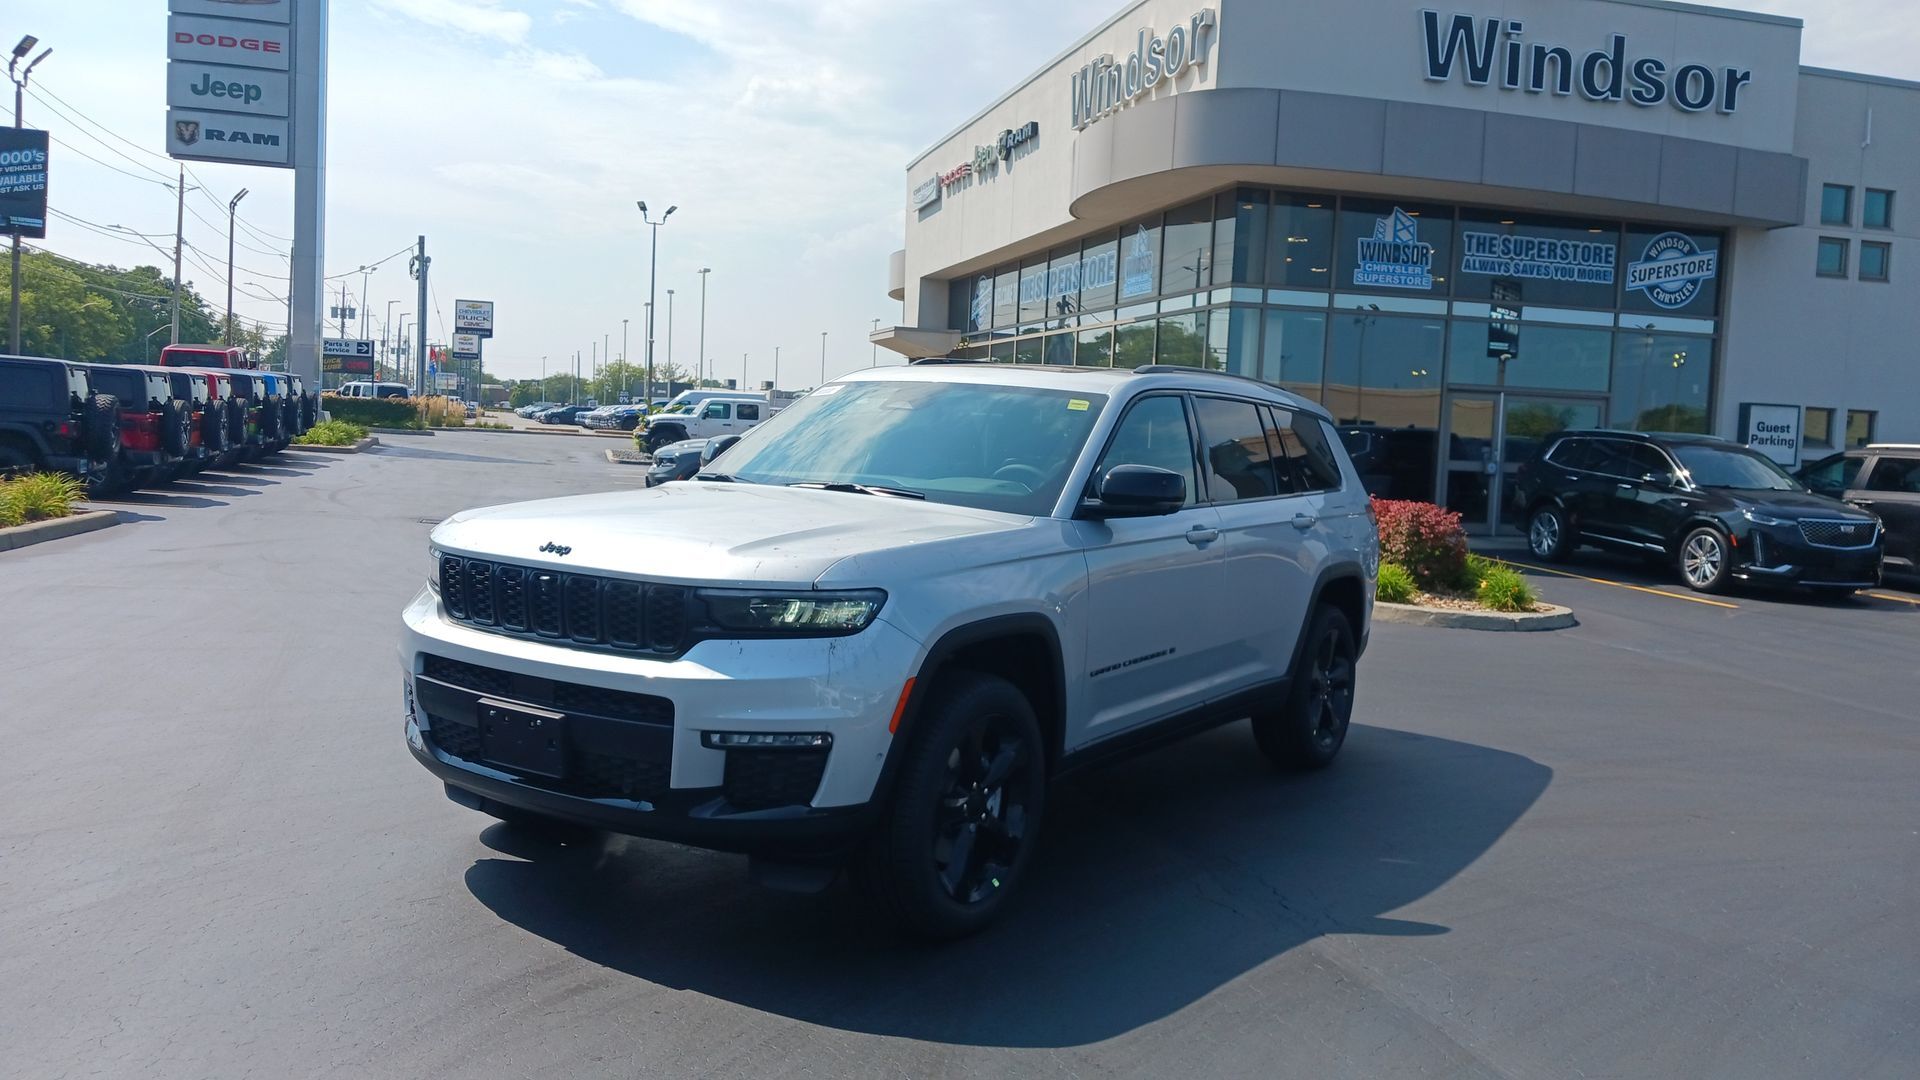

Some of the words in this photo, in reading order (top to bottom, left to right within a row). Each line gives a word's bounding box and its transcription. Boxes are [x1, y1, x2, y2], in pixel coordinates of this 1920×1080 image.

[175, 32, 281, 53] DODGE
[1071, 9, 1212, 131] Windsor
[1421, 9, 1751, 114] Windsor
[190, 73, 262, 105] Jeep
[205, 128, 280, 147] RAM
[1007, 122, 1035, 148] RAM
[5, 164, 43, 173] VEHICLES
[13, 184, 30, 193] ASK
[1360, 241, 1430, 266] WINDSOR
[1465, 234, 1498, 254] THE
[1501, 236, 1614, 265] SUPERSTORE
[1649, 237, 1690, 258] WINDSOR
[1035, 250, 1117, 303] SUPERSTORE
[1357, 272, 1431, 286] SUPERSTORE
[1365, 263, 1422, 275] CHRYSLER
[1463, 257, 1511, 274] ALWAYS
[1513, 261, 1550, 277] SAVES
[1553, 263, 1575, 279] YOU
[1577, 266, 1613, 283] MORE!
[1630, 258, 1713, 283] SUPERSTORE
[1653, 281, 1695, 304] CHRYSLER
[1757, 421, 1791, 434] Guest
[1750, 434, 1795, 449] Parking
[539, 541, 572, 557] Jeep
